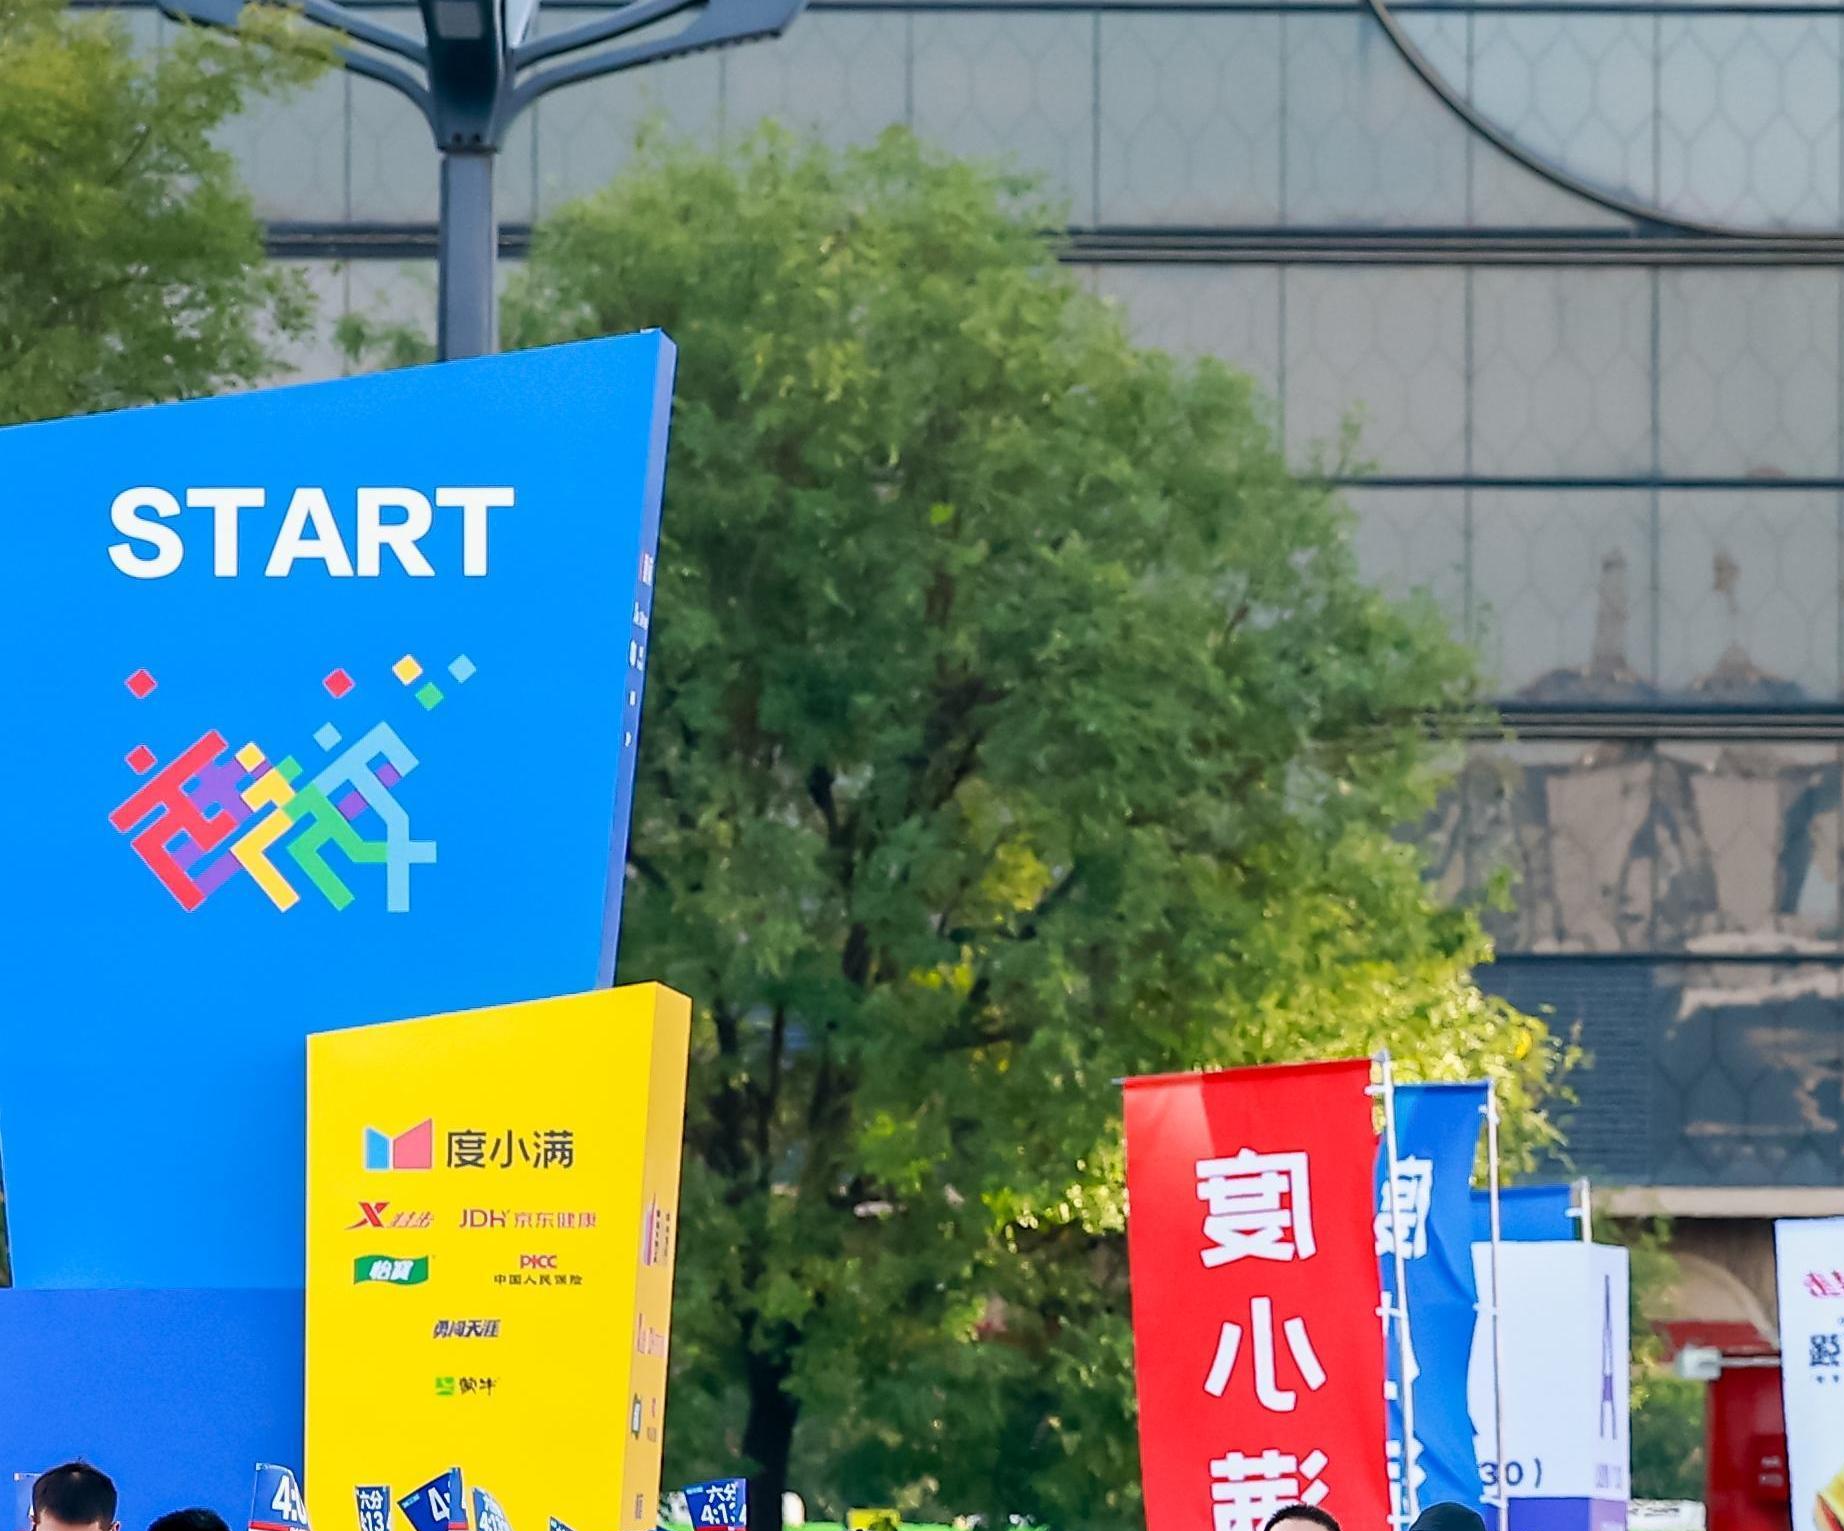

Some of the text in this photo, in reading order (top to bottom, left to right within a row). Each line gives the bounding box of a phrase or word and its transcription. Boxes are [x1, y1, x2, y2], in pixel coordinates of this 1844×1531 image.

[107, 485, 516, 579] START
[446, 1129, 573, 1169] 度小满
[514, 1210, 596, 1229] 京东健康
[519, 1255, 558, 1268] PICC
[493, 1273, 583, 1286] 中国人民保险
[433, 1319, 500, 1339] 勇闯天涯
